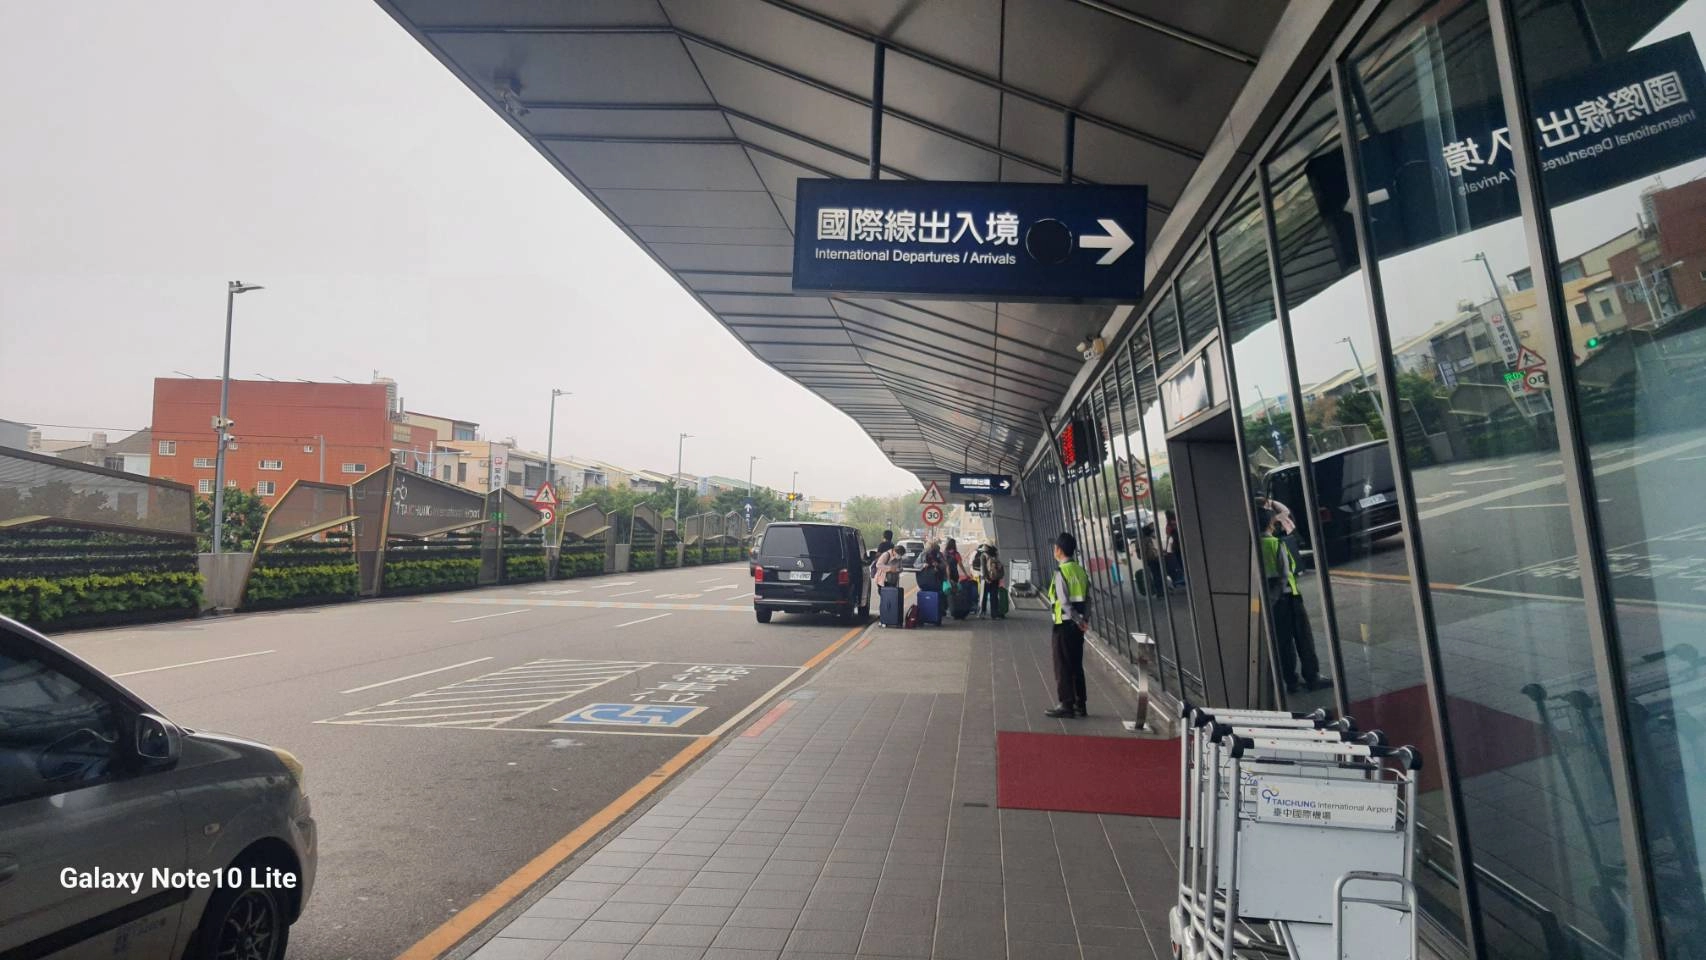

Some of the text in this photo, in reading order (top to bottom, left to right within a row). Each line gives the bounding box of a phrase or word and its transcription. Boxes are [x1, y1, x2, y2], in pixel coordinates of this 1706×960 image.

[817, 208, 1019, 246] 國際線出入境
[815, 247, 1016, 265] International Departures / Arrivals
[927, 512, 939, 520] 30
[1273, 799, 1393, 814] TAICHUNG International Airport
